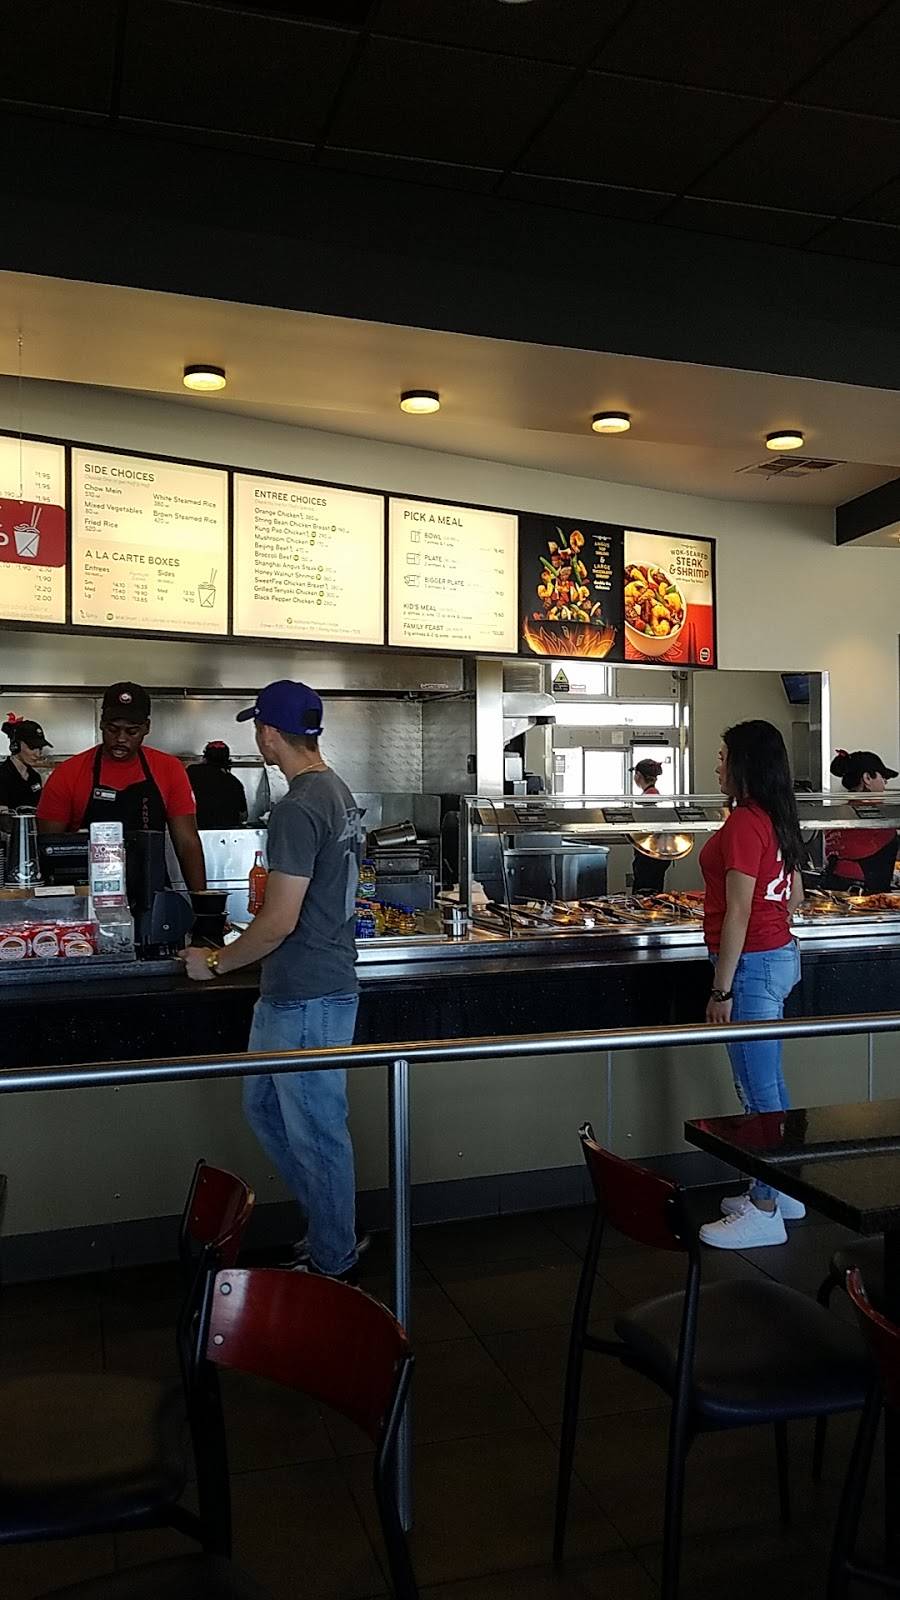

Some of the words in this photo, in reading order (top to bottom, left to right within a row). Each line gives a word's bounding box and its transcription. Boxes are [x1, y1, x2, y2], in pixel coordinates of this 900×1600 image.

[84, 464, 108, 475] SIDE
[111, 468, 154, 482] CHOICES
[153, 492, 172, 501] White
[174, 496, 201, 505] Steamed
[203, 500, 216, 508] Rice
[255, 490, 288, 501] ENTREE
[291, 495, 327, 506] CHOICES
[84, 501, 104, 509] Mixed
[107, 504, 142, 514] Vegetables
[255, 507, 276, 516] Orange
[277, 510, 300, 518] Chicken
[153, 510, 172, 518] Brown
[175, 513, 202, 522] Steamed
[255, 516, 272, 525] String
[404, 510, 426, 522] PICK
[429, 514, 436, 523] A
[438, 515, 463, 527] MEAL
[84, 518, 101, 526] Fried
[104, 520, 118, 528] Rice
[284, 528, 306, 536] Chicken
[424, 532, 441, 540] BOWL
[255, 534, 284, 542] Mushroom
[255, 542, 274, 551] Beijing
[85, 550, 92, 558] A
[96, 551, 109, 560] LA
[112, 552, 145, 564] CARTE
[148, 556, 180, 567] BOXES
[670, 549, 709, 560] WOK-SEARED
[255, 560, 281, 568] Shanghai
[283, 562, 300, 570] Angus
[676, 556, 703, 568] STEAK
[84, 564, 110, 573] Entrees
[425, 576, 445, 585] BIGGER
[403, 622, 423, 630] FAMILY
[142, 798, 150, 830] PANDA
